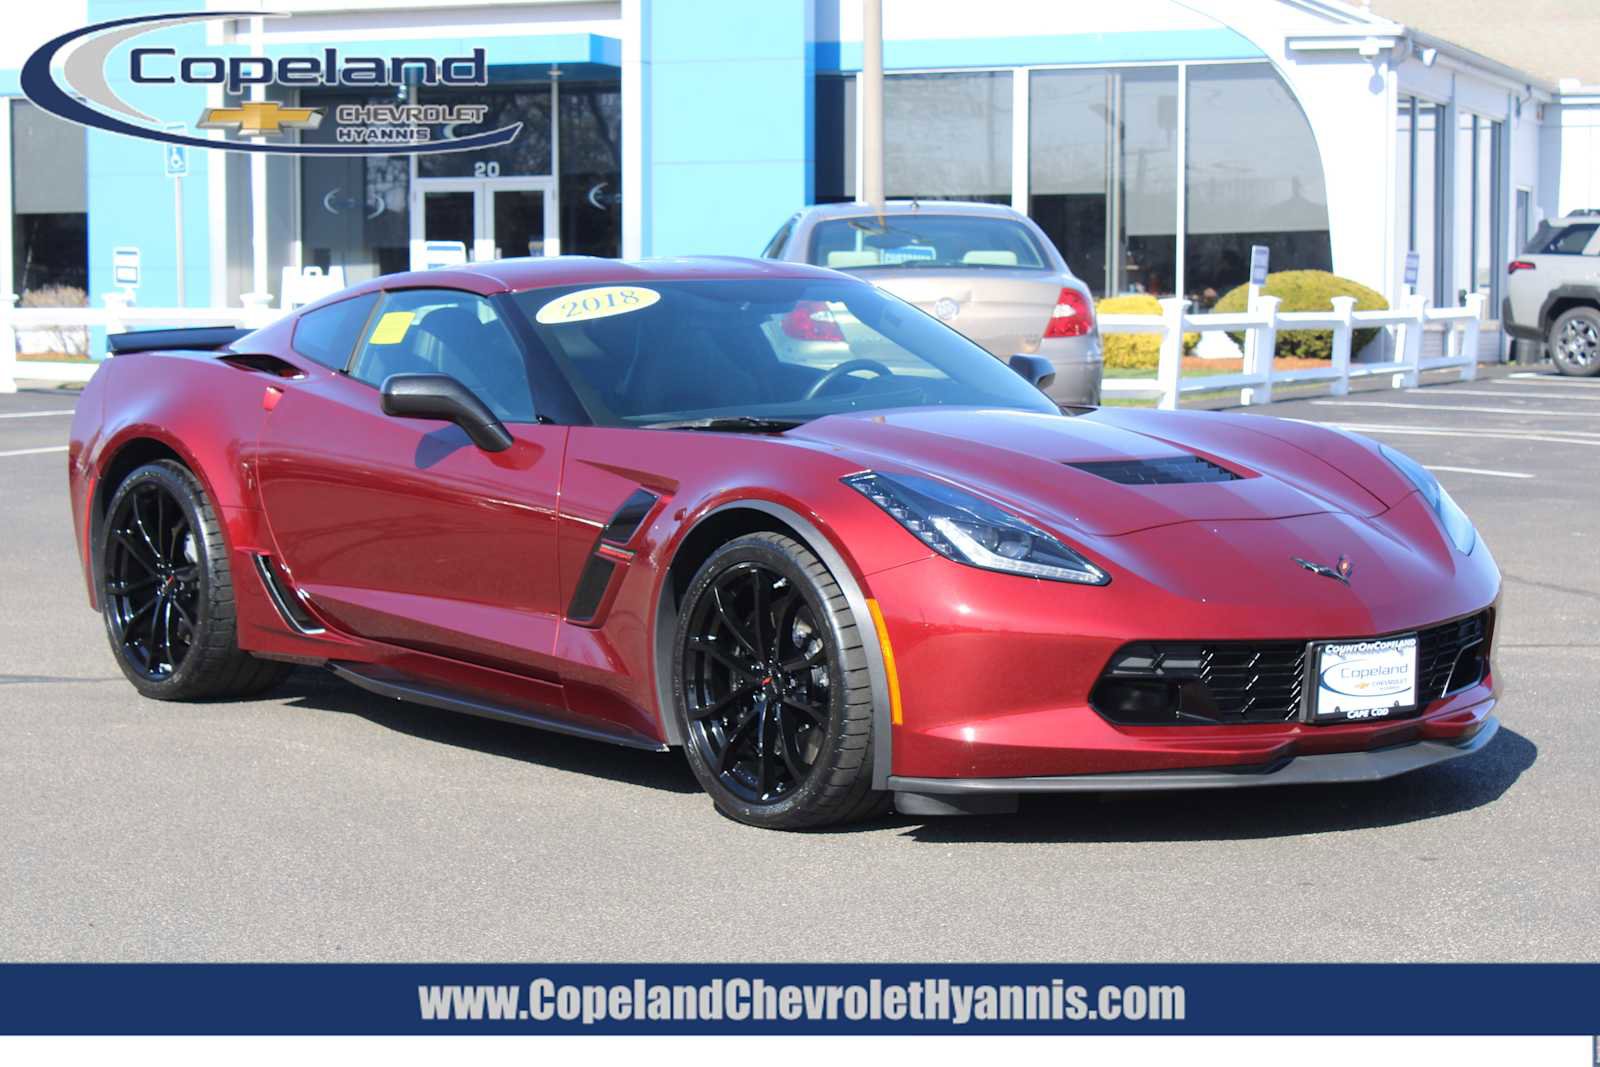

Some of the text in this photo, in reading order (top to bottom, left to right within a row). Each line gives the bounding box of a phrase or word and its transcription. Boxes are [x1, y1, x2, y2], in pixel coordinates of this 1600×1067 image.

[474, 161, 500, 177] 20
[561, 290, 640, 318] 2018
[1340, 664, 1409, 679] Copeland
[1347, 708, 1389, 719] CAPE COD
